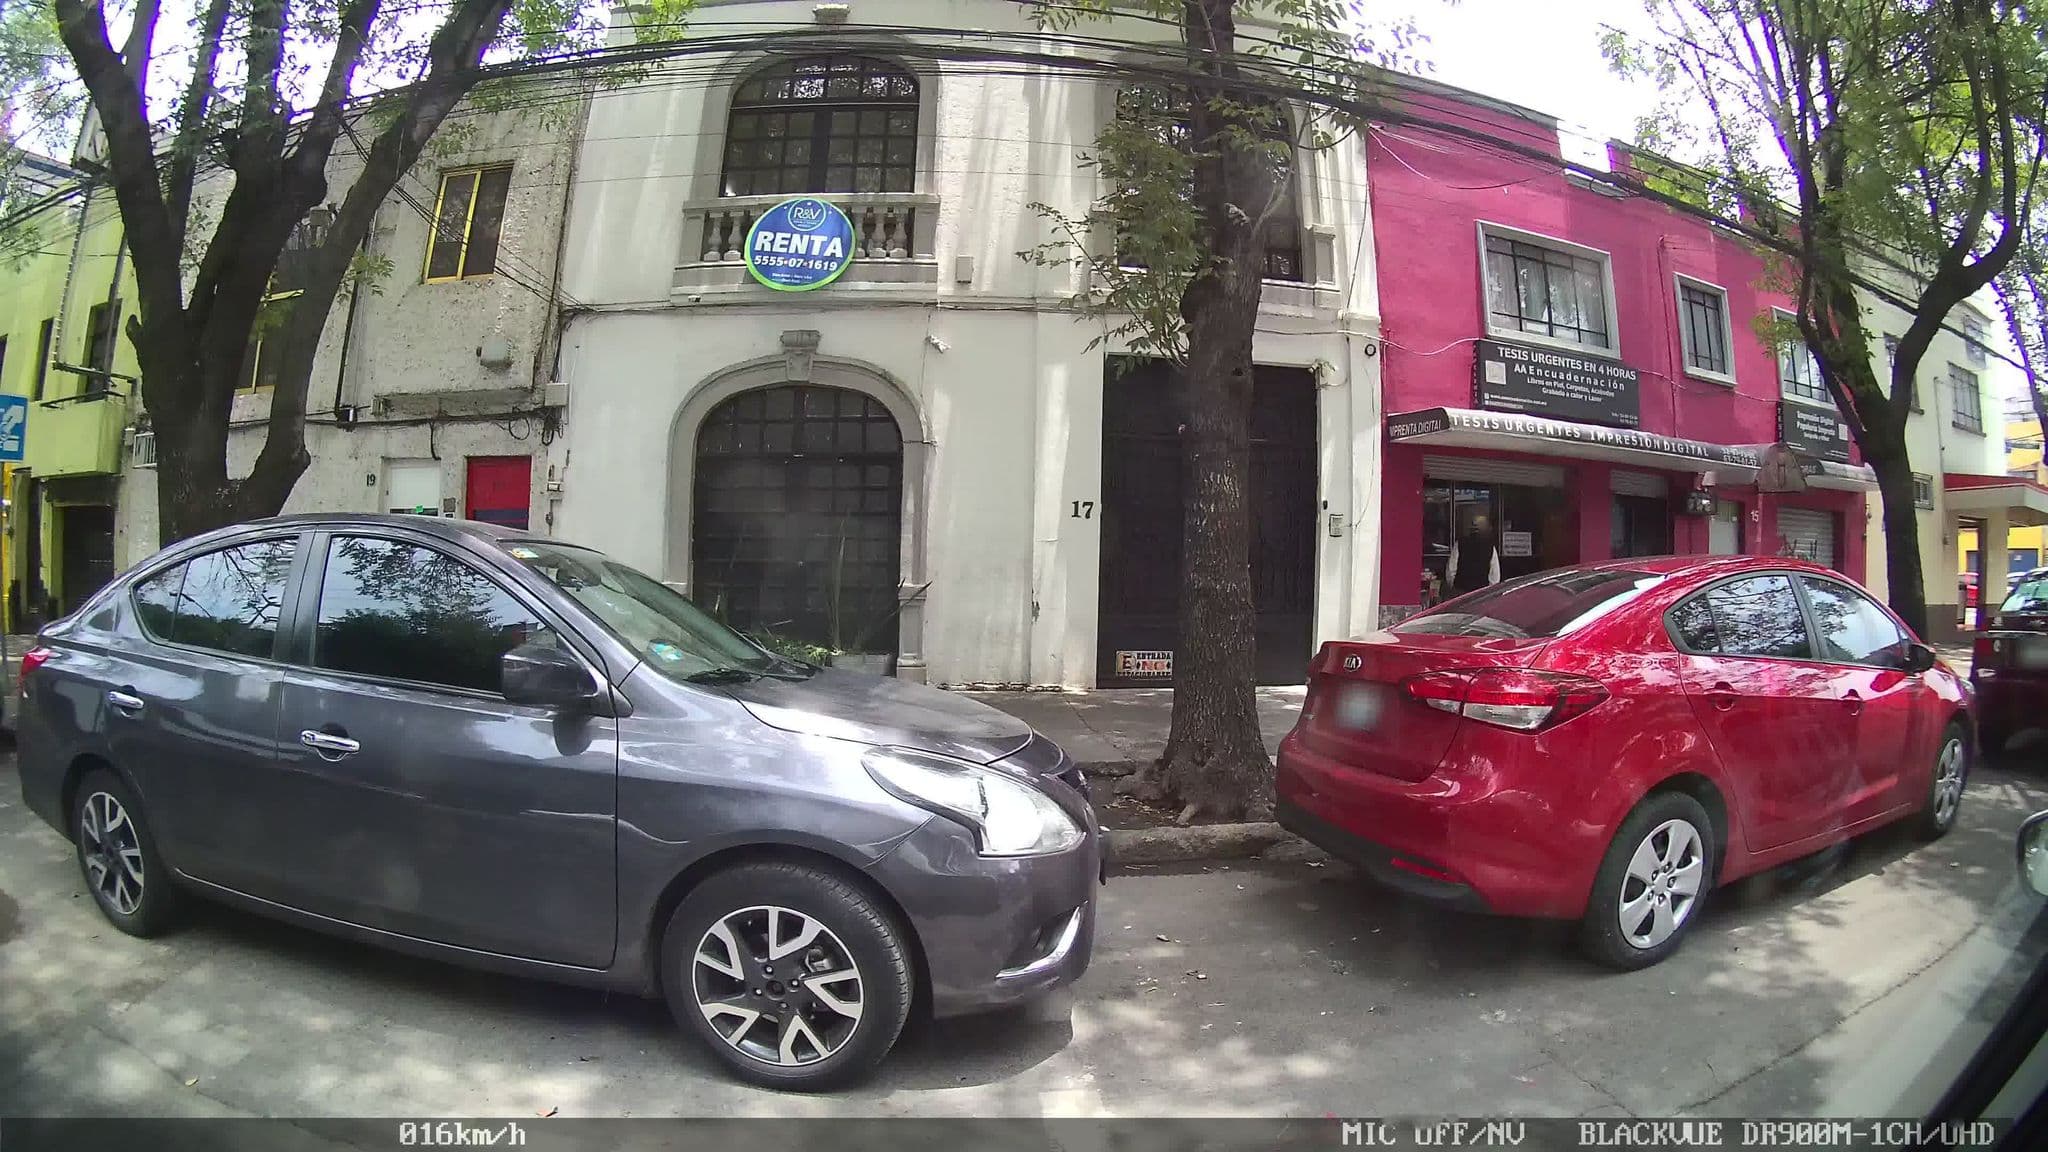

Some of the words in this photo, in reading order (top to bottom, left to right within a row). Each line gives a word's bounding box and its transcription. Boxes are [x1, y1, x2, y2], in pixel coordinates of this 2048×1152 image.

[793, 207, 821, 219] R&V
[754, 231, 843, 258] RENTA
[1497, 347, 1529, 361] TESIS
[1531, 351, 1582, 370] URGENTES
[1584, 361, 1596, 373] EN
[1598, 364, 1604, 374] 4
[1607, 366, 1636, 381] HORAS
[1451, 415, 1500, 430] TESIS
[1504, 418, 1581, 438] URGENTES
[1663, 438, 1709, 457] DIGITAL
[367, 473, 376, 487] 19
[1071, 501, 1094, 519] 17
[1750, 510, 1759, 522] 15
[1136, 652, 1171, 660] ENTRADA
